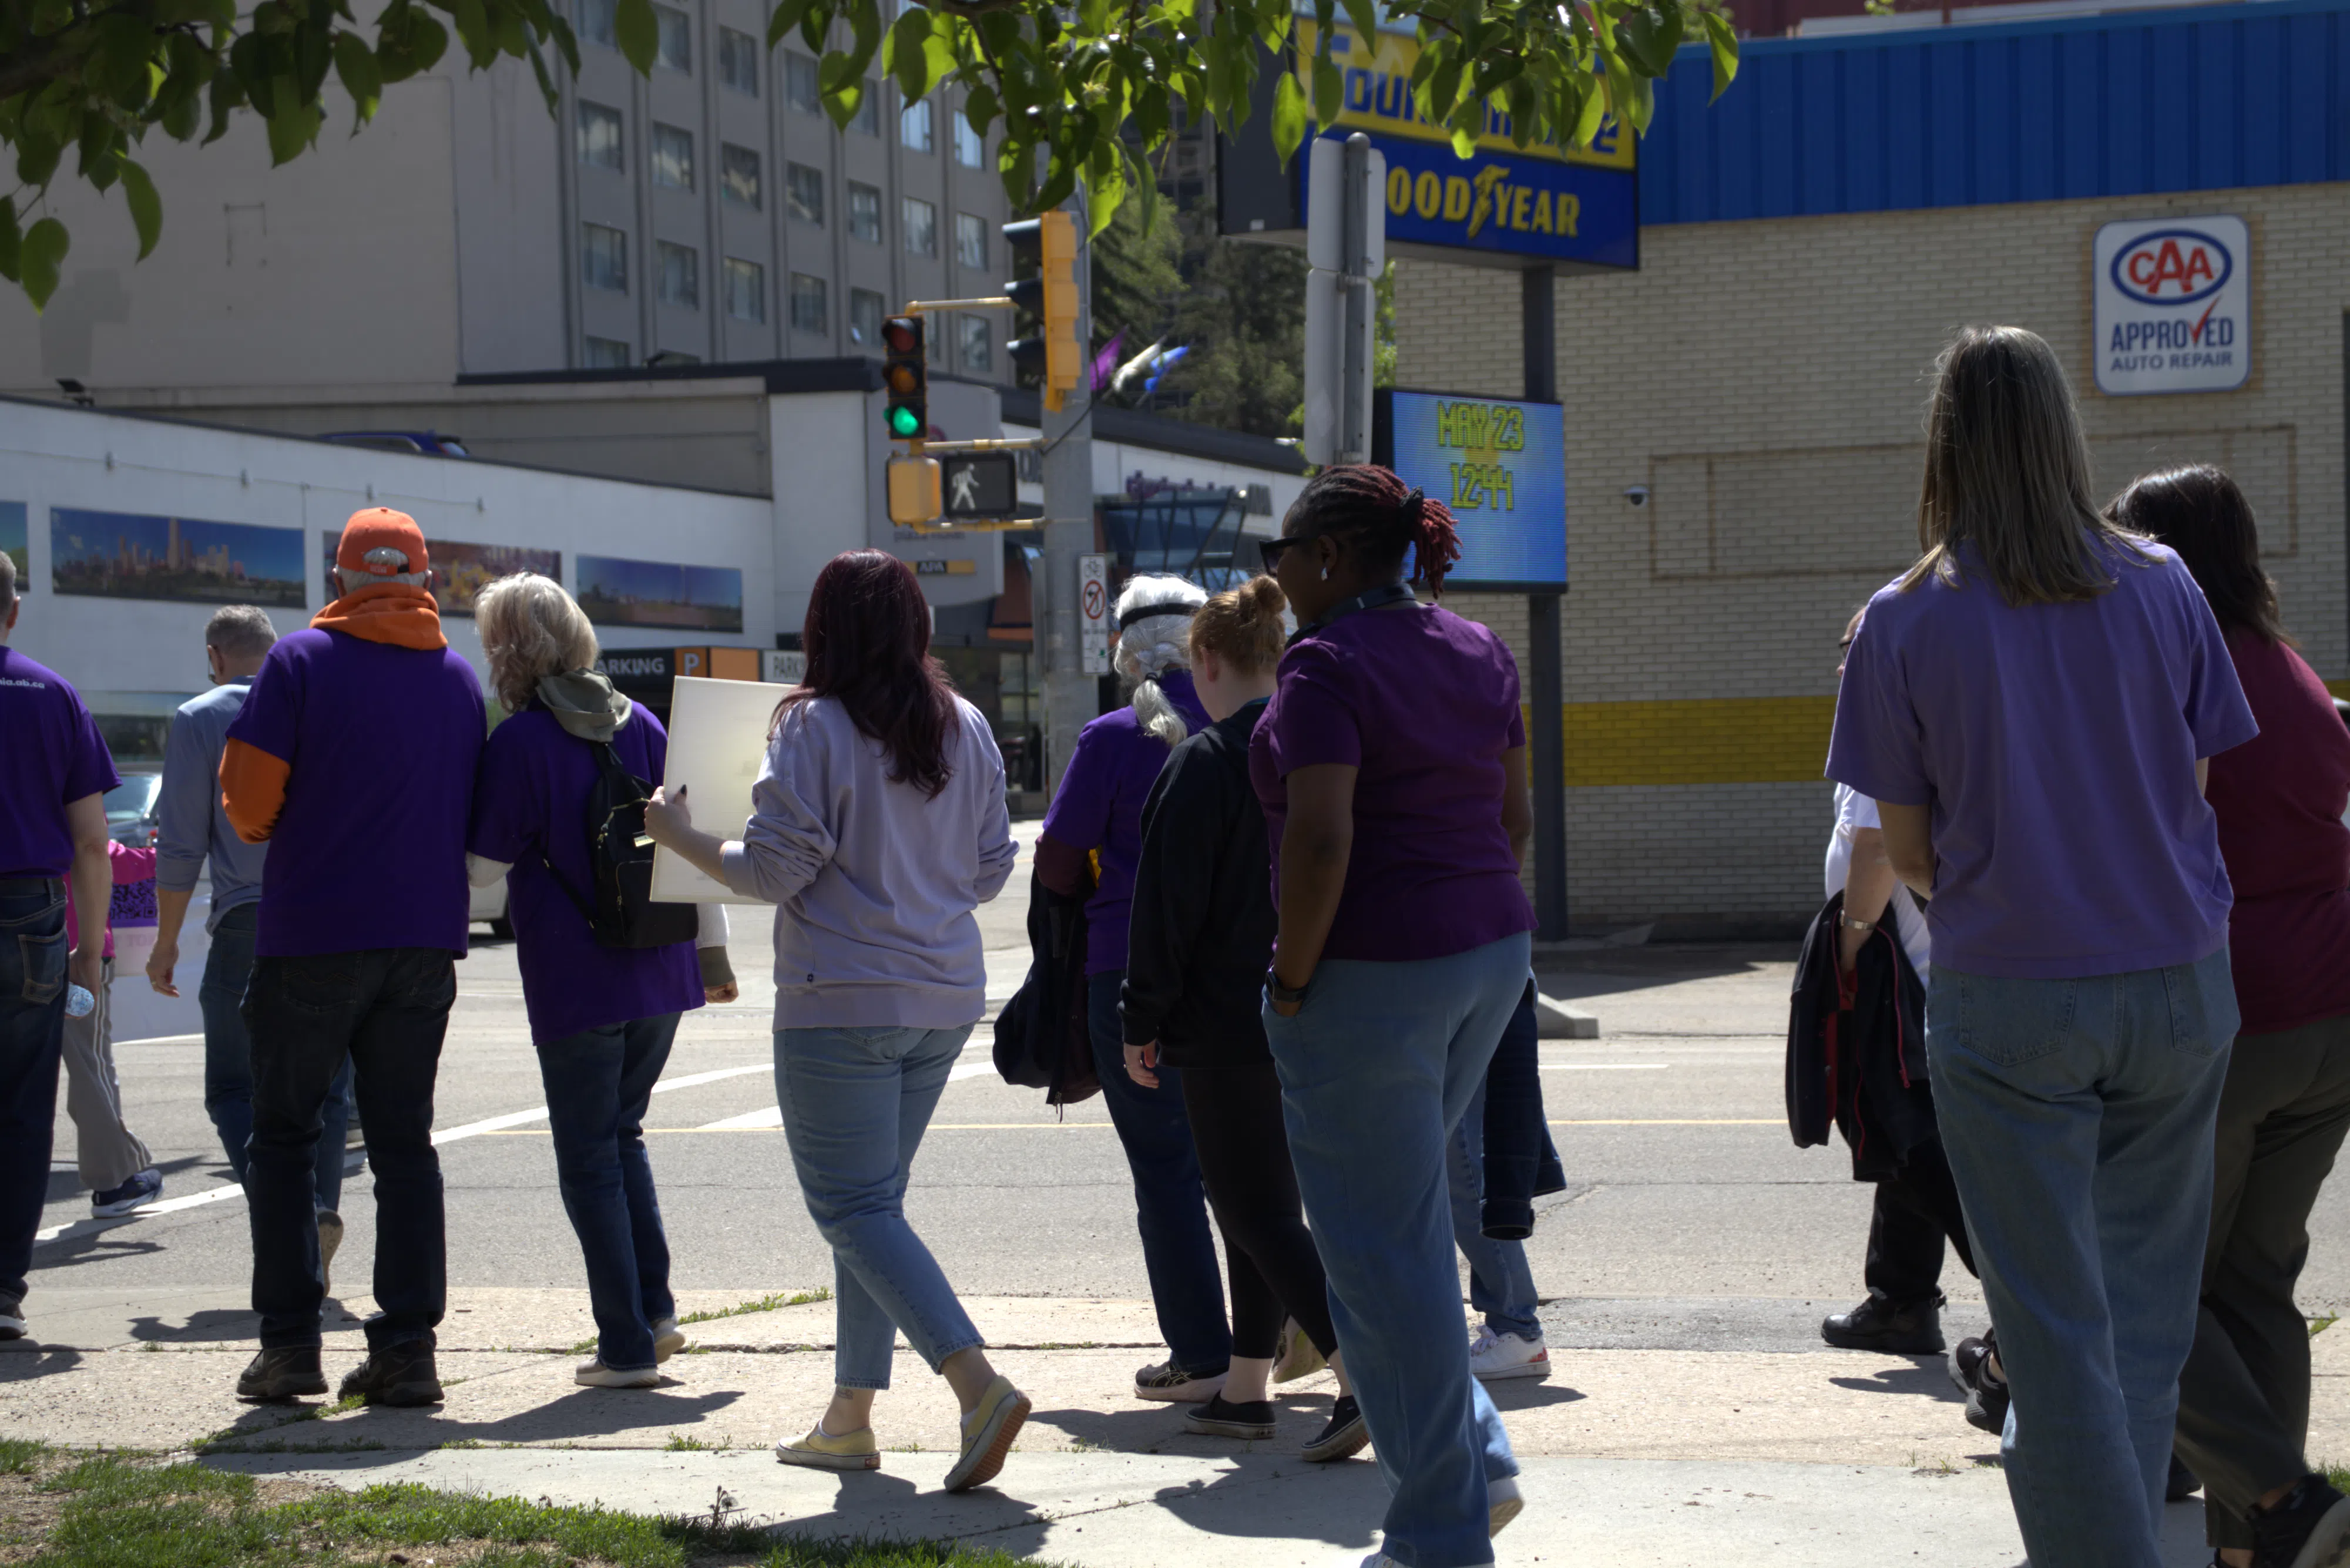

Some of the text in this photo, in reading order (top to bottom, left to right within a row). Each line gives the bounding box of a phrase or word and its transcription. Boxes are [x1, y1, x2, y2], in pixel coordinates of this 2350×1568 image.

[1386, 165, 1580, 237] OODYEAR
[2128, 239, 2214, 294] CAA
[2110, 316, 2234, 352] APPROVED
[2110, 352, 2232, 371] AUTO REPAIR
[1438, 401, 1525, 451] MAY 23
[594, 657, 665, 676] ARKING
[684, 653, 700, 676] P
